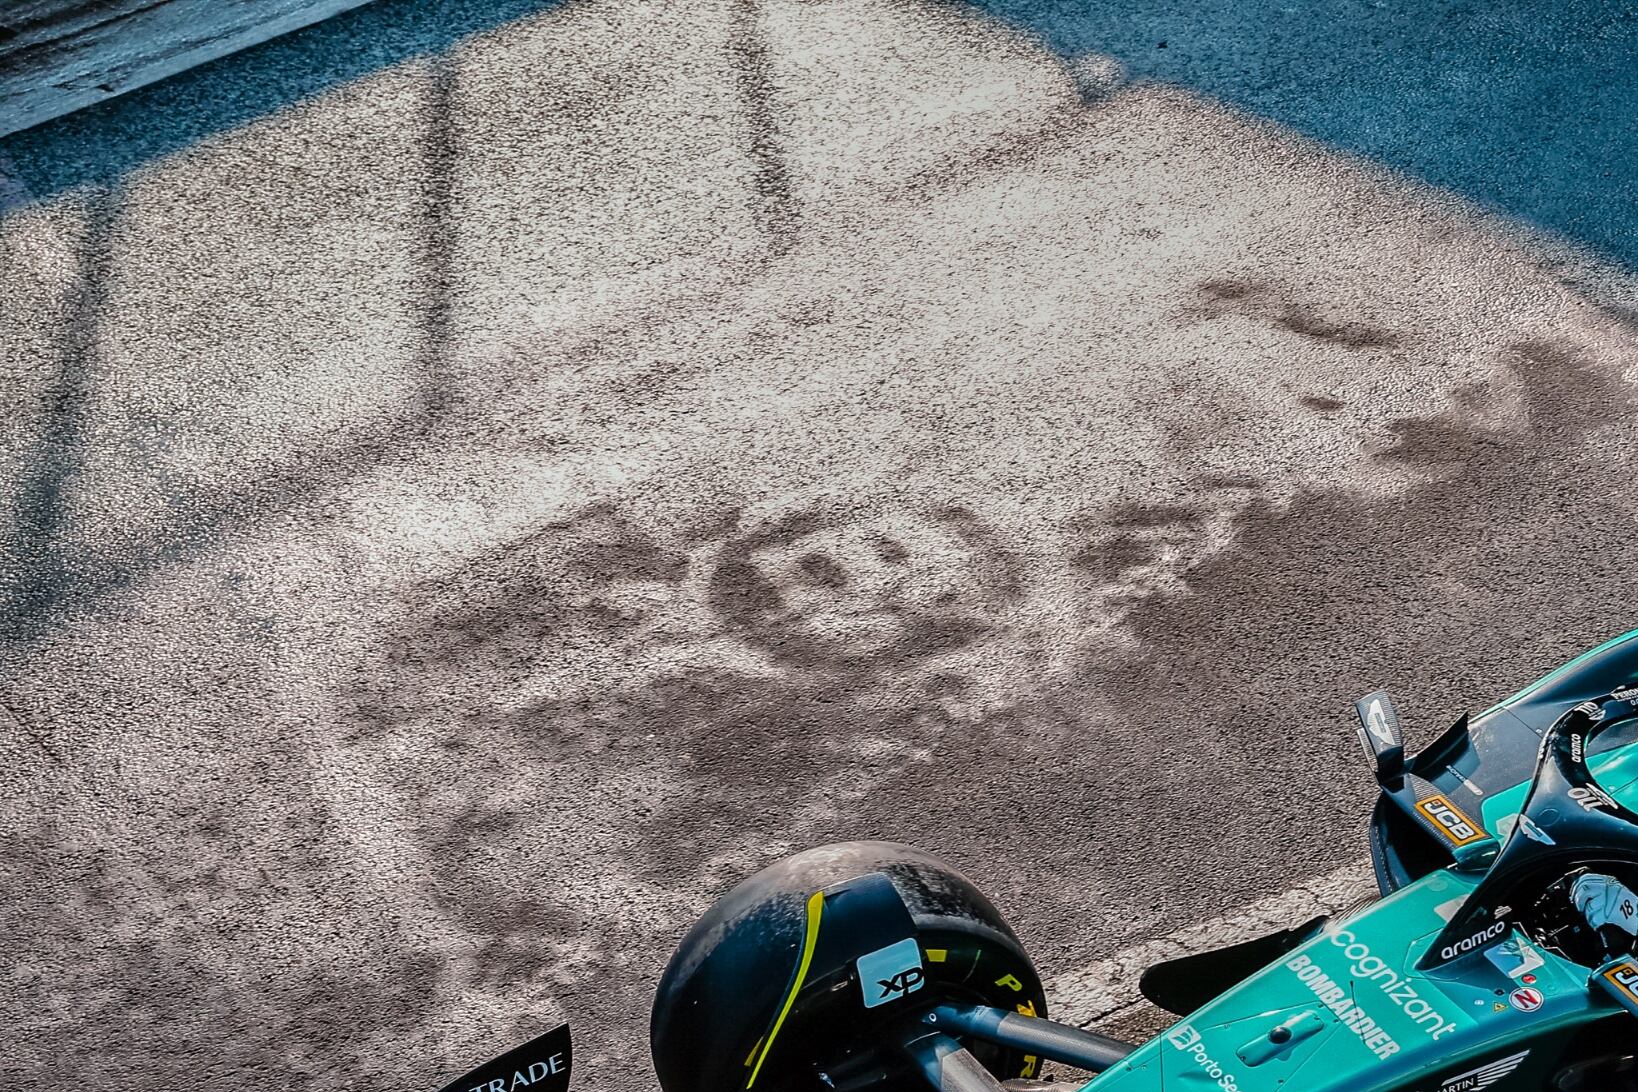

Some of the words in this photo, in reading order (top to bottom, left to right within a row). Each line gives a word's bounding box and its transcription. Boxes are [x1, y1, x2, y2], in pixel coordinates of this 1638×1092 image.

[1571, 733, 1582, 763] aramco
[1423, 802, 1475, 841] JCB
[1619, 899, 1634, 920] 18
[1441, 921, 1505, 960] aramco
[994, 973, 1023, 993] P
[1331, 926, 1457, 1042] cognizant
[1513, 989, 1539, 1009] N
[1287, 954, 1404, 1063] BOMBARDIER
